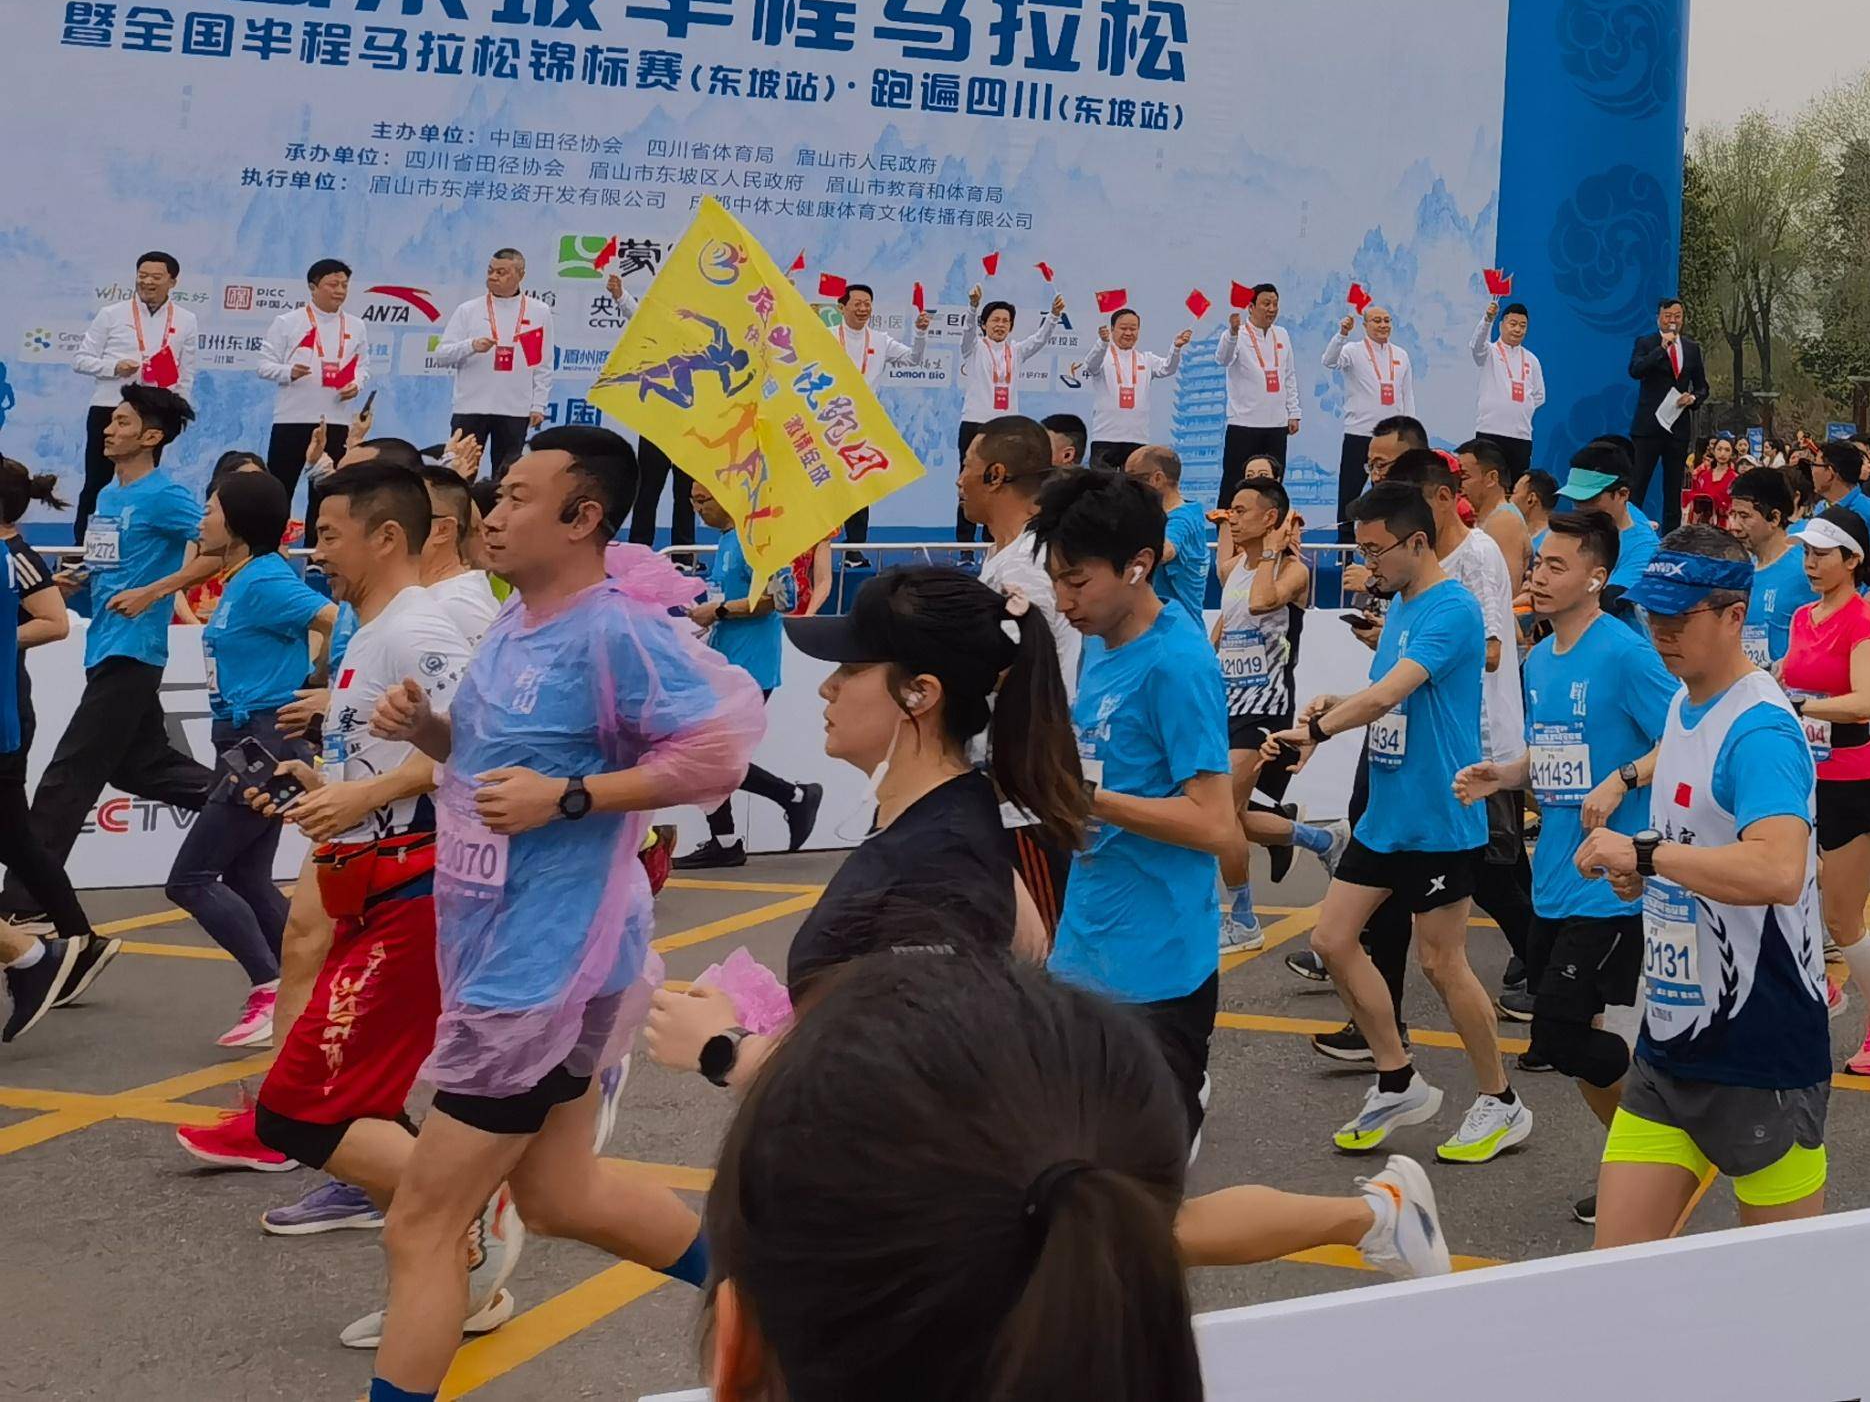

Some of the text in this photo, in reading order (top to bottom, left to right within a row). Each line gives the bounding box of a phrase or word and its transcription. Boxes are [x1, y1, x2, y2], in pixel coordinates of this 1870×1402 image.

[490, 128, 623, 155] 中国田径协会
[648, 139, 774, 164] 四川省体育局
[799, 148, 937, 175] 眉山市人民政府
[405, 149, 565, 178] 四川省田径协会
[589, 161, 804, 192] 眉山市东坡区人民政府
[826, 176, 1003, 204] 眉山市教育和体育局
[368, 175, 666, 210] 眉山市东岸投资开发有限公司
[618, 239, 673, 277] 蒙
[256, 288, 285, 298] PICC
[590, 295, 622, 317] 央
[361, 305, 410, 323] ANTA
[589, 319, 626, 329] CCTV
[1531, 760, 1584, 787] A11431
